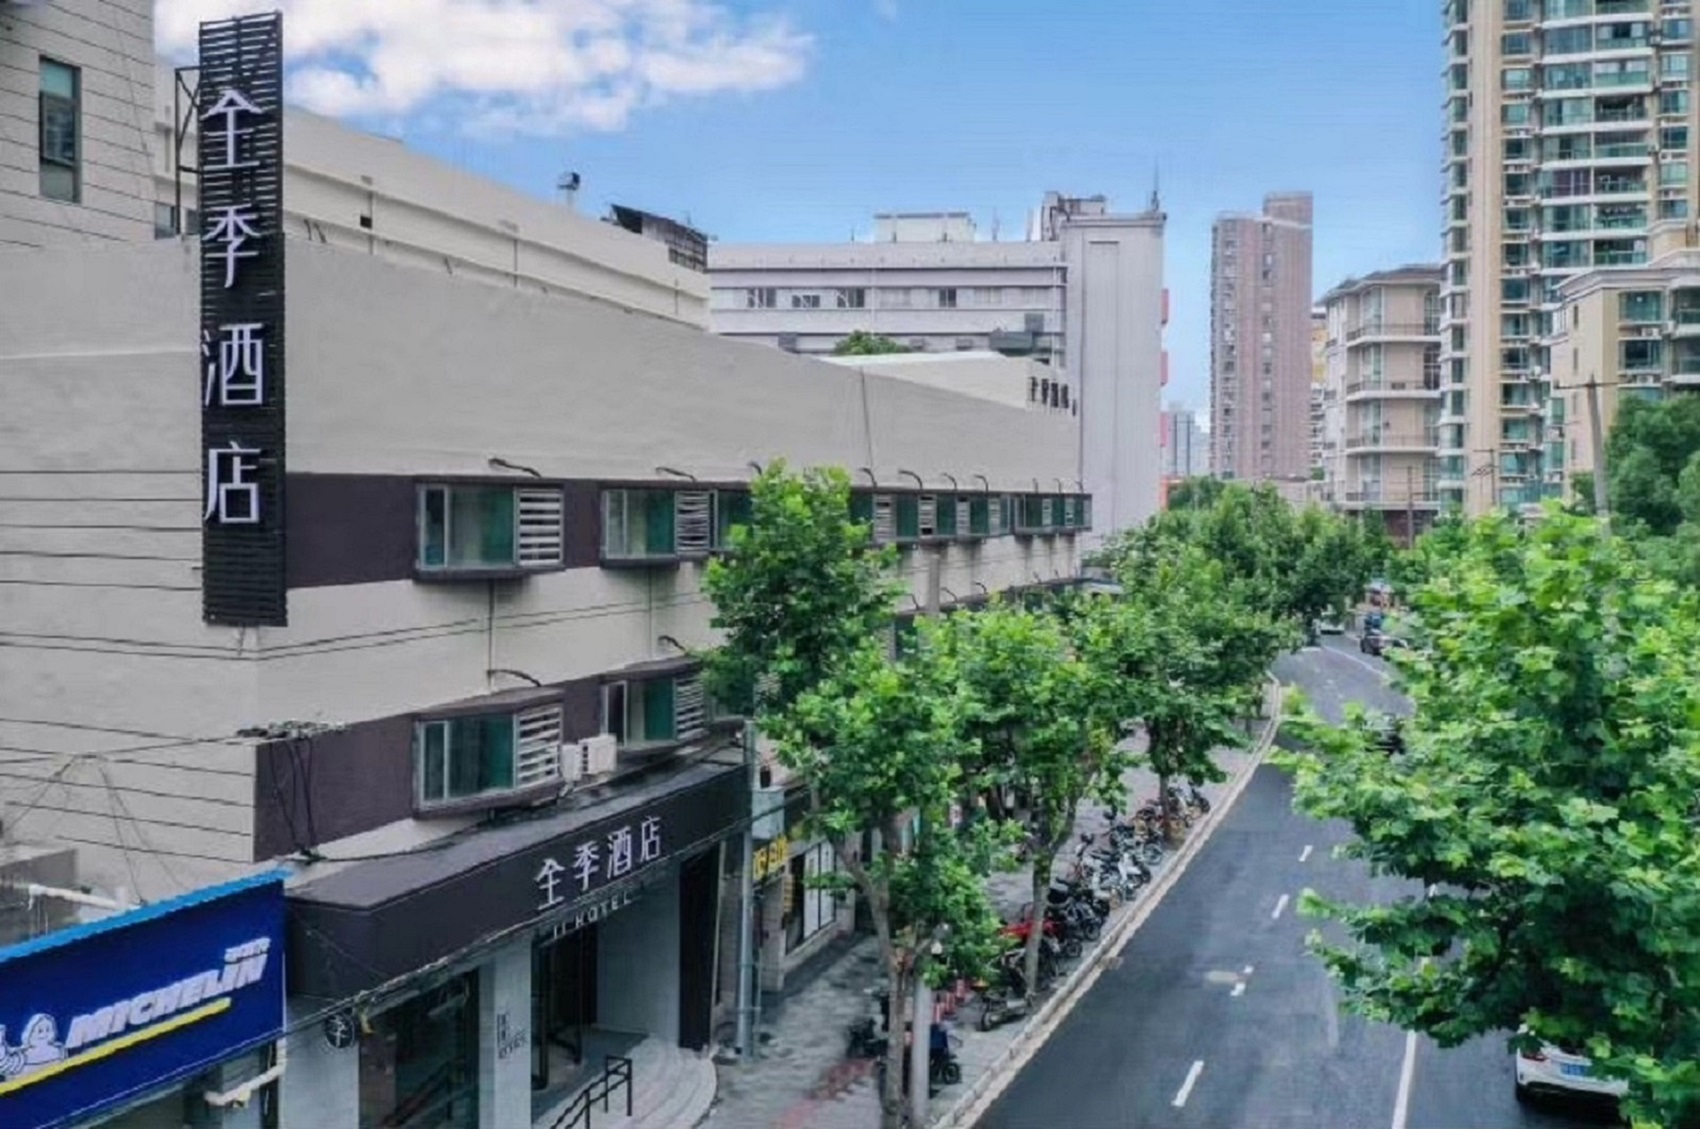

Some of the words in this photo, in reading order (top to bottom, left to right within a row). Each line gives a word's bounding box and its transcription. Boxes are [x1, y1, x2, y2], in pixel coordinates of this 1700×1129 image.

[201, 89, 263, 525] 全季酒店
[534, 815, 661, 911] 全季酒店
[575, 890, 633, 930] HOTEL
[65, 952, 268, 1049] MICHELIN
